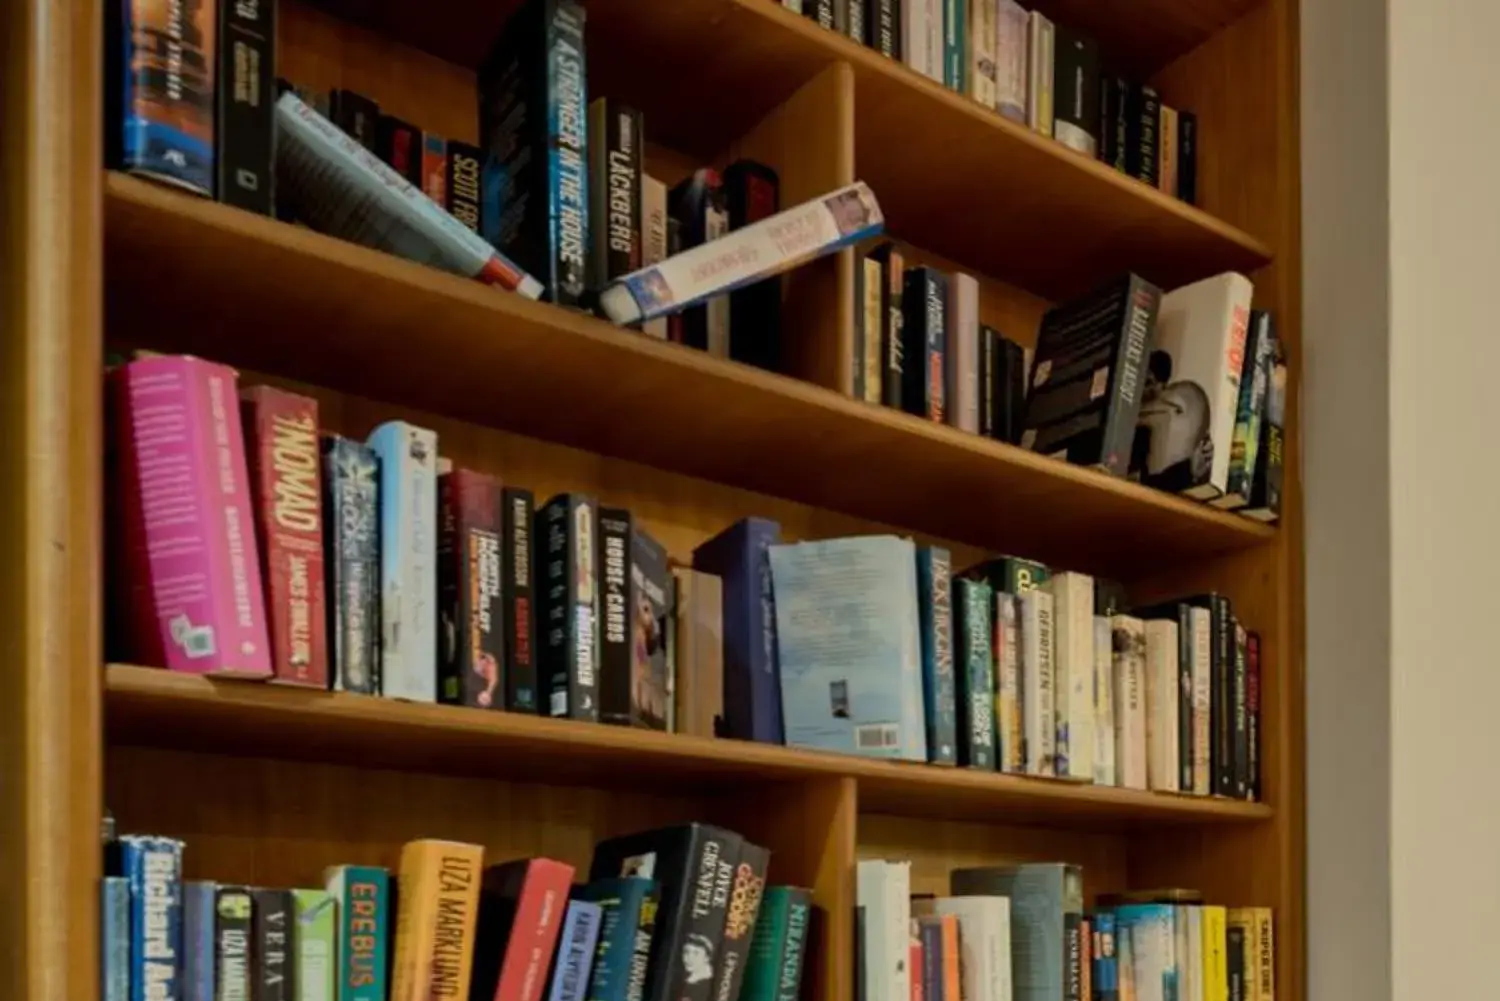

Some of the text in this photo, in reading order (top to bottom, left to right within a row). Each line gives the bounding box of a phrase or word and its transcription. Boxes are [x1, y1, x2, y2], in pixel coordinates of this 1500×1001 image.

[556, 40, 584, 264] A STRANGER IN THE HOUSE
[609, 150, 635, 254] LÄCKBERG
[272, 422, 318, 533] NOMAD
[605, 536, 625, 586] HOUSE
[604, 593, 625, 644] CARDS
[932, 557, 953, 678] JACK HIGGINS
[144, 850, 176, 955] Richard
[691, 839, 720, 920] GRENFELL
[713, 860, 734, 909] JOYCE
[221, 929, 249, 956] LIZA
[264, 911, 286, 986] VERA
[348, 882, 378, 988] EREBUS
[430, 856, 472, 999] LIZA MARKLUND
[634, 928, 652, 952] AN
[780, 903, 808, 989] MIRANDA
